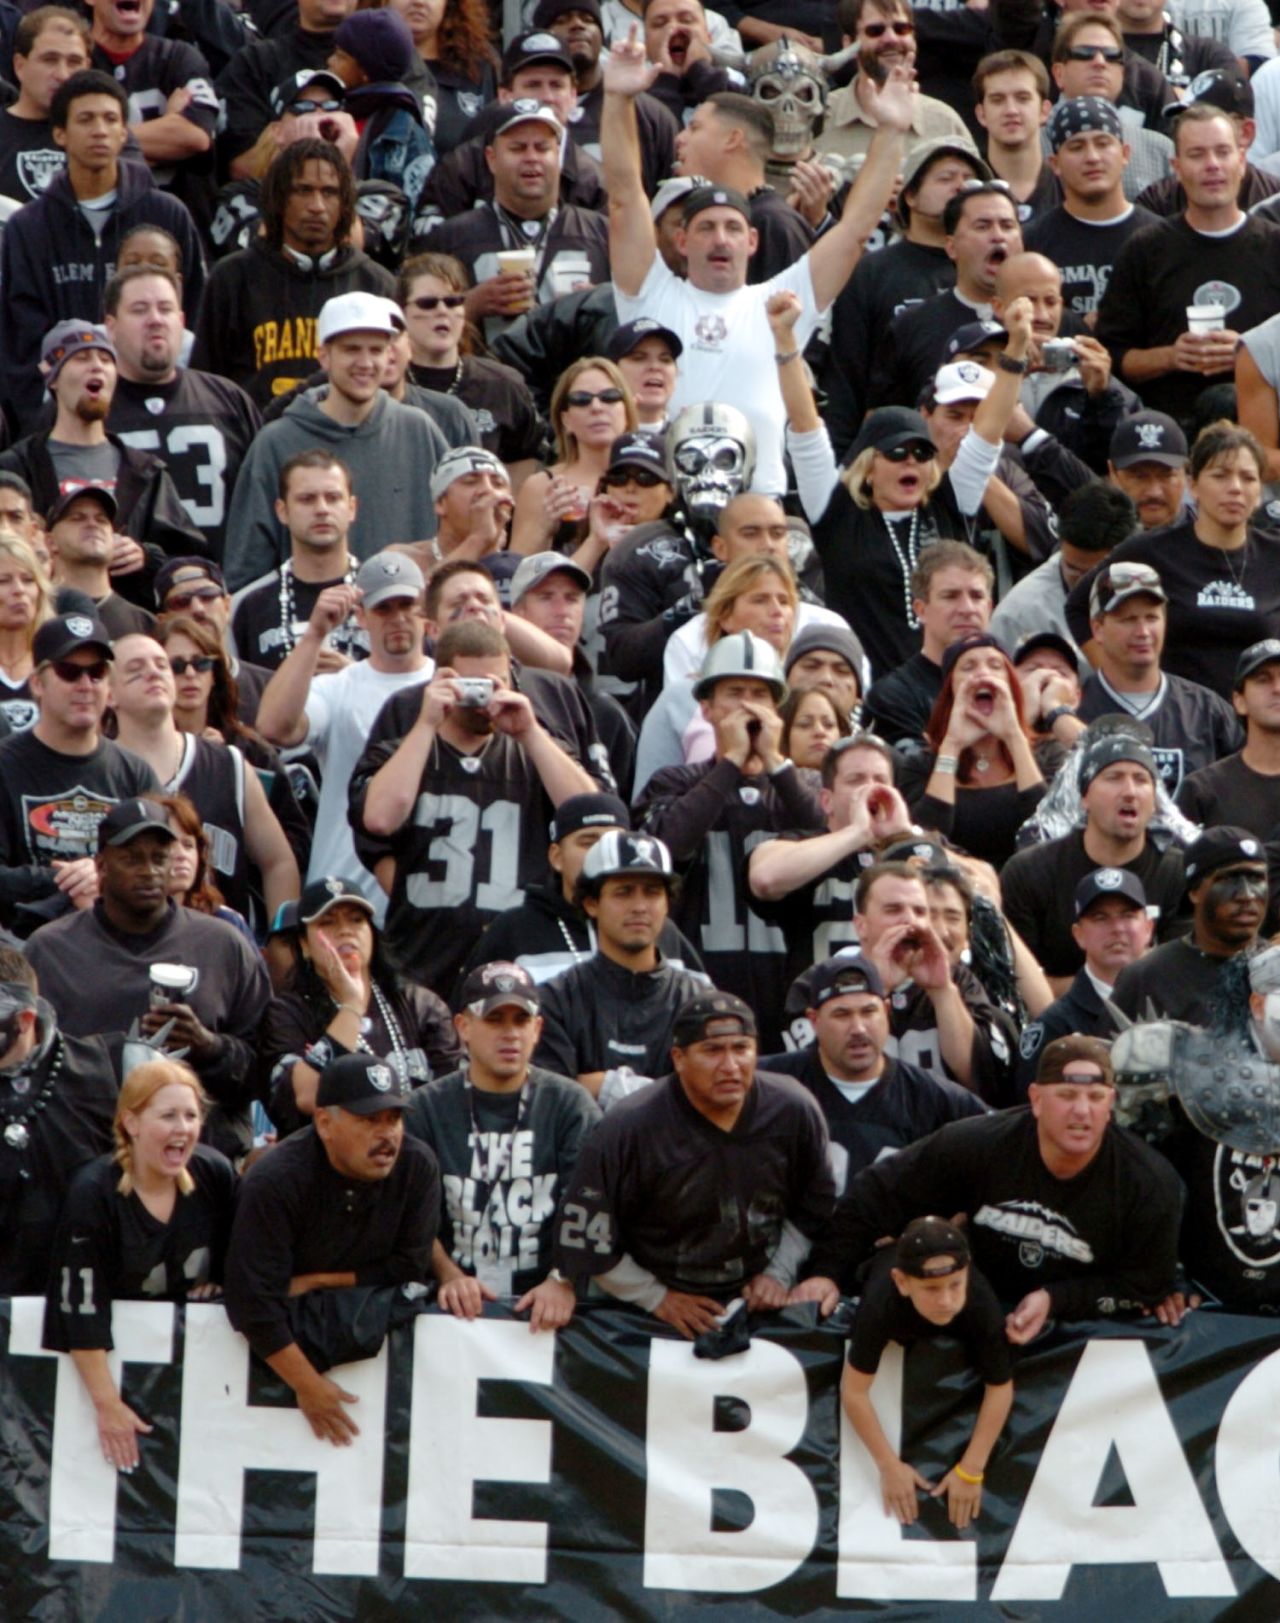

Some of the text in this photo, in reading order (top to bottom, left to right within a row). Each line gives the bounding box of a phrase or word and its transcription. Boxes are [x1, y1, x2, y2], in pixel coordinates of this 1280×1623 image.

[254, 317, 320, 370] FRAN
[406, 791, 526, 912] 31
[467, 1130, 534, 1181] THE
[443, 1173, 558, 1227] BLACK
[452, 1221, 541, 1271] HOLE
[559, 1203, 612, 1255] 24
[973, 1204, 1095, 1264] RAIDERS
[60, 1267, 97, 1314] 11
[9, 1295, 557, 1584] THE
